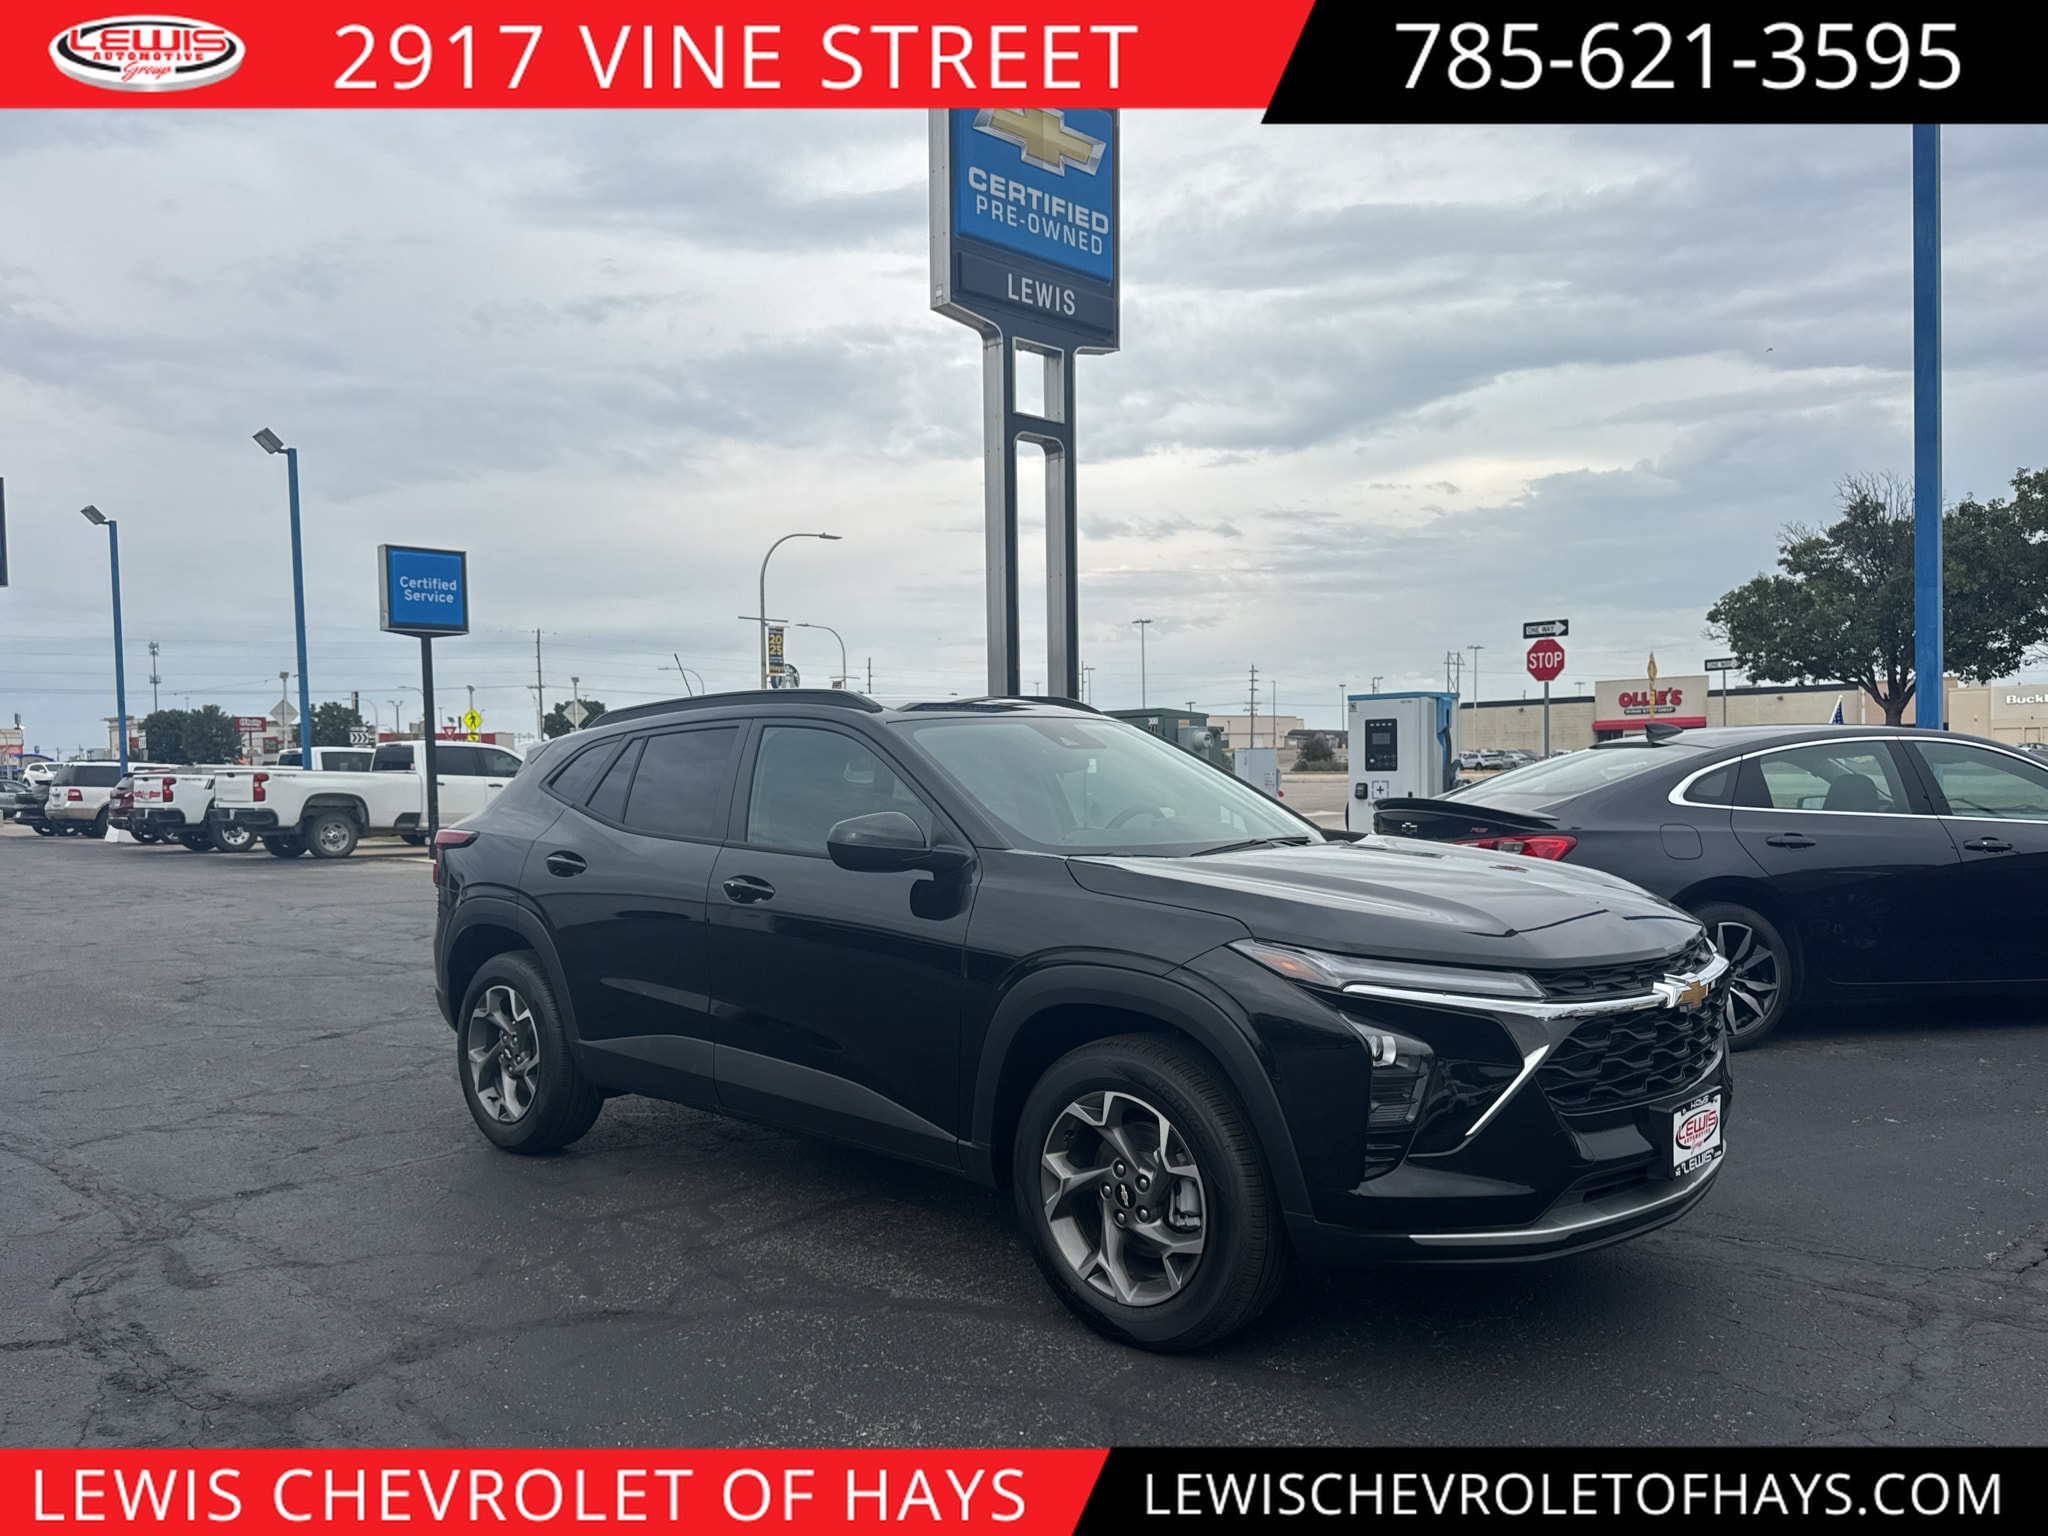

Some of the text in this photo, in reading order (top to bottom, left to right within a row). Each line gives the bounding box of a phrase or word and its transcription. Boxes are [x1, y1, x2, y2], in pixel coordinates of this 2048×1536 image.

[968, 166, 1109, 235] CERTIFIED
[976, 194, 1103, 255] PRE-OWNED
[1008, 273, 1076, 316] LEWIS
[400, 576, 457, 591] Certified
[404, 589, 454, 603] Service
[1527, 625, 1539, 633] ONE
[1529, 651, 1562, 669] STOP
[1679, 1110, 1716, 1140] LEWIS
